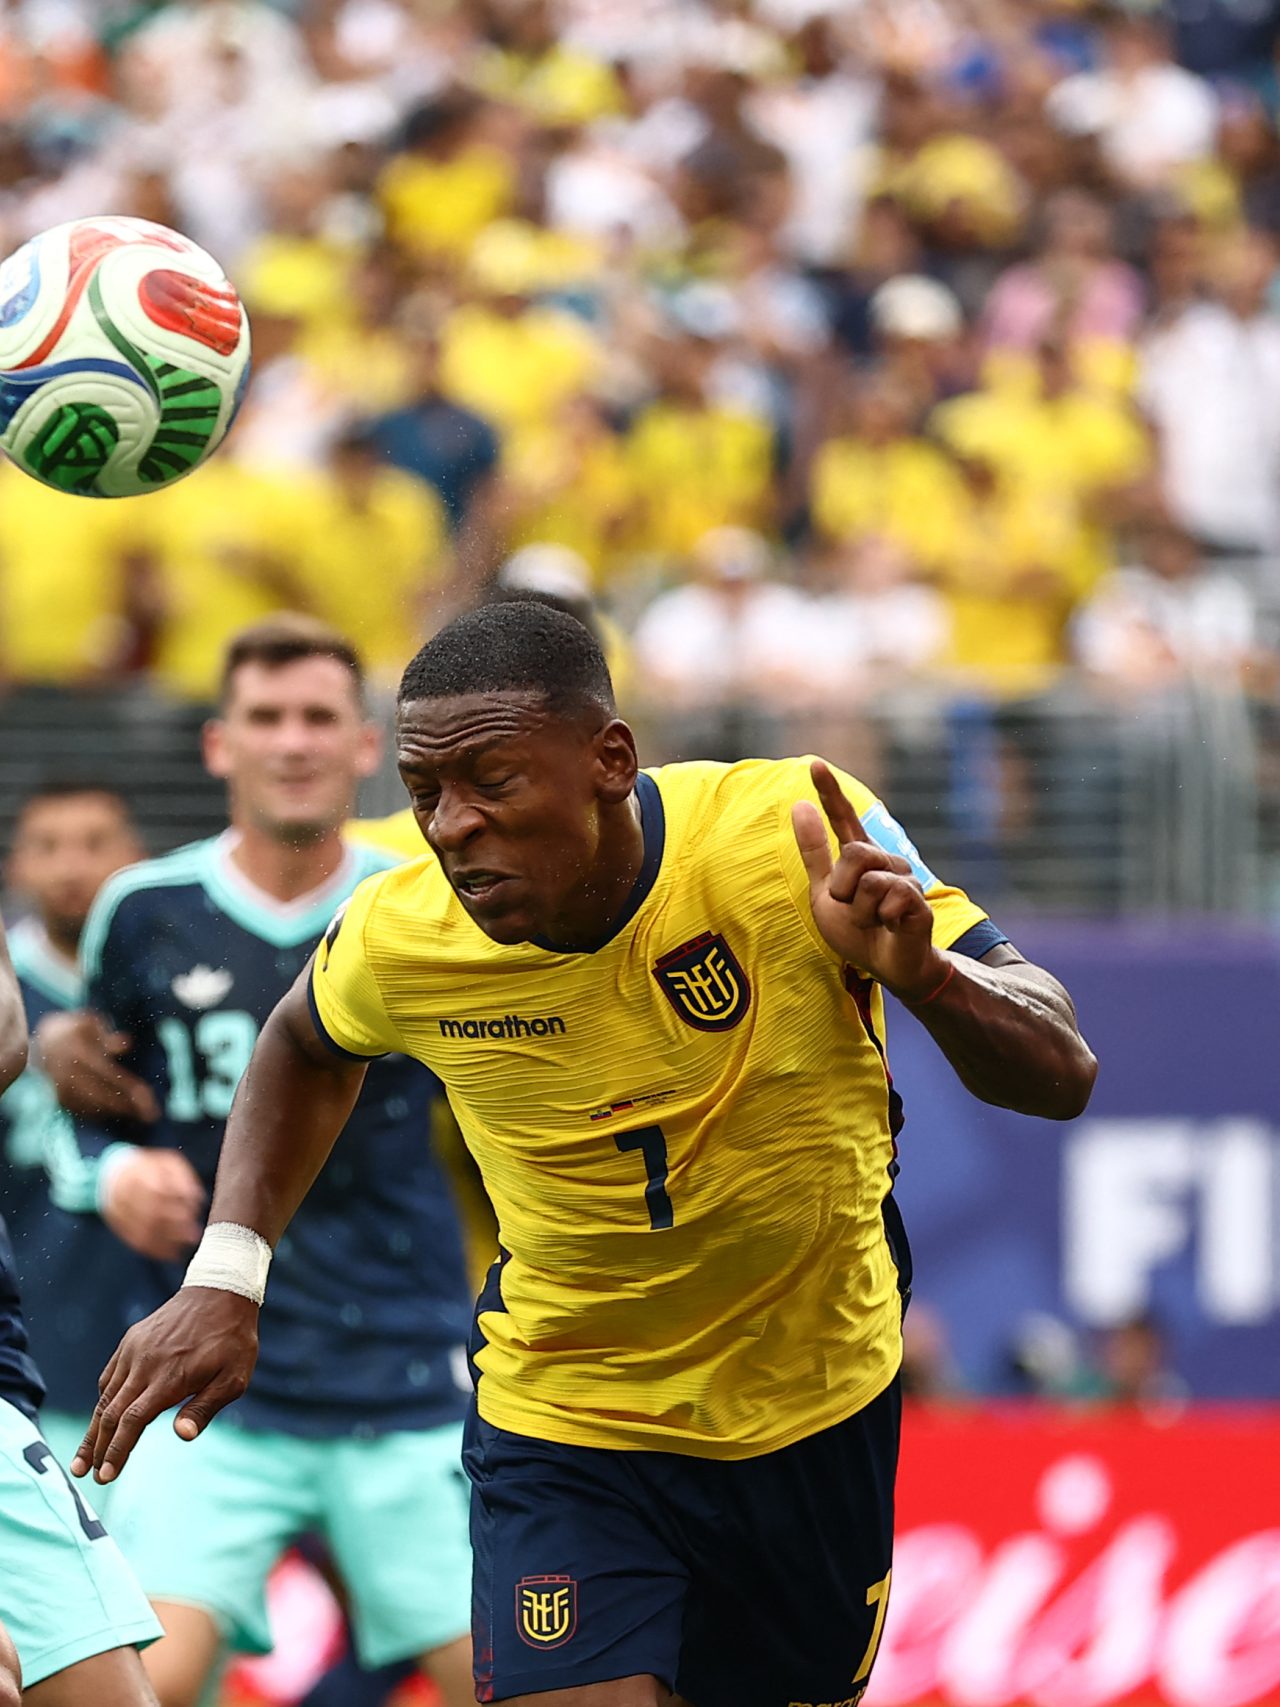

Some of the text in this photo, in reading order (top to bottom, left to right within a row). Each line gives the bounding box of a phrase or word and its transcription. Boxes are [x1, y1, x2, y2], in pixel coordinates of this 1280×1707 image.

[157, 1009, 260, 1121] 13
[439, 1015, 566, 1039] marathon
[613, 1125, 674, 1230] 7
[1063, 1118, 1280, 1328] FI
